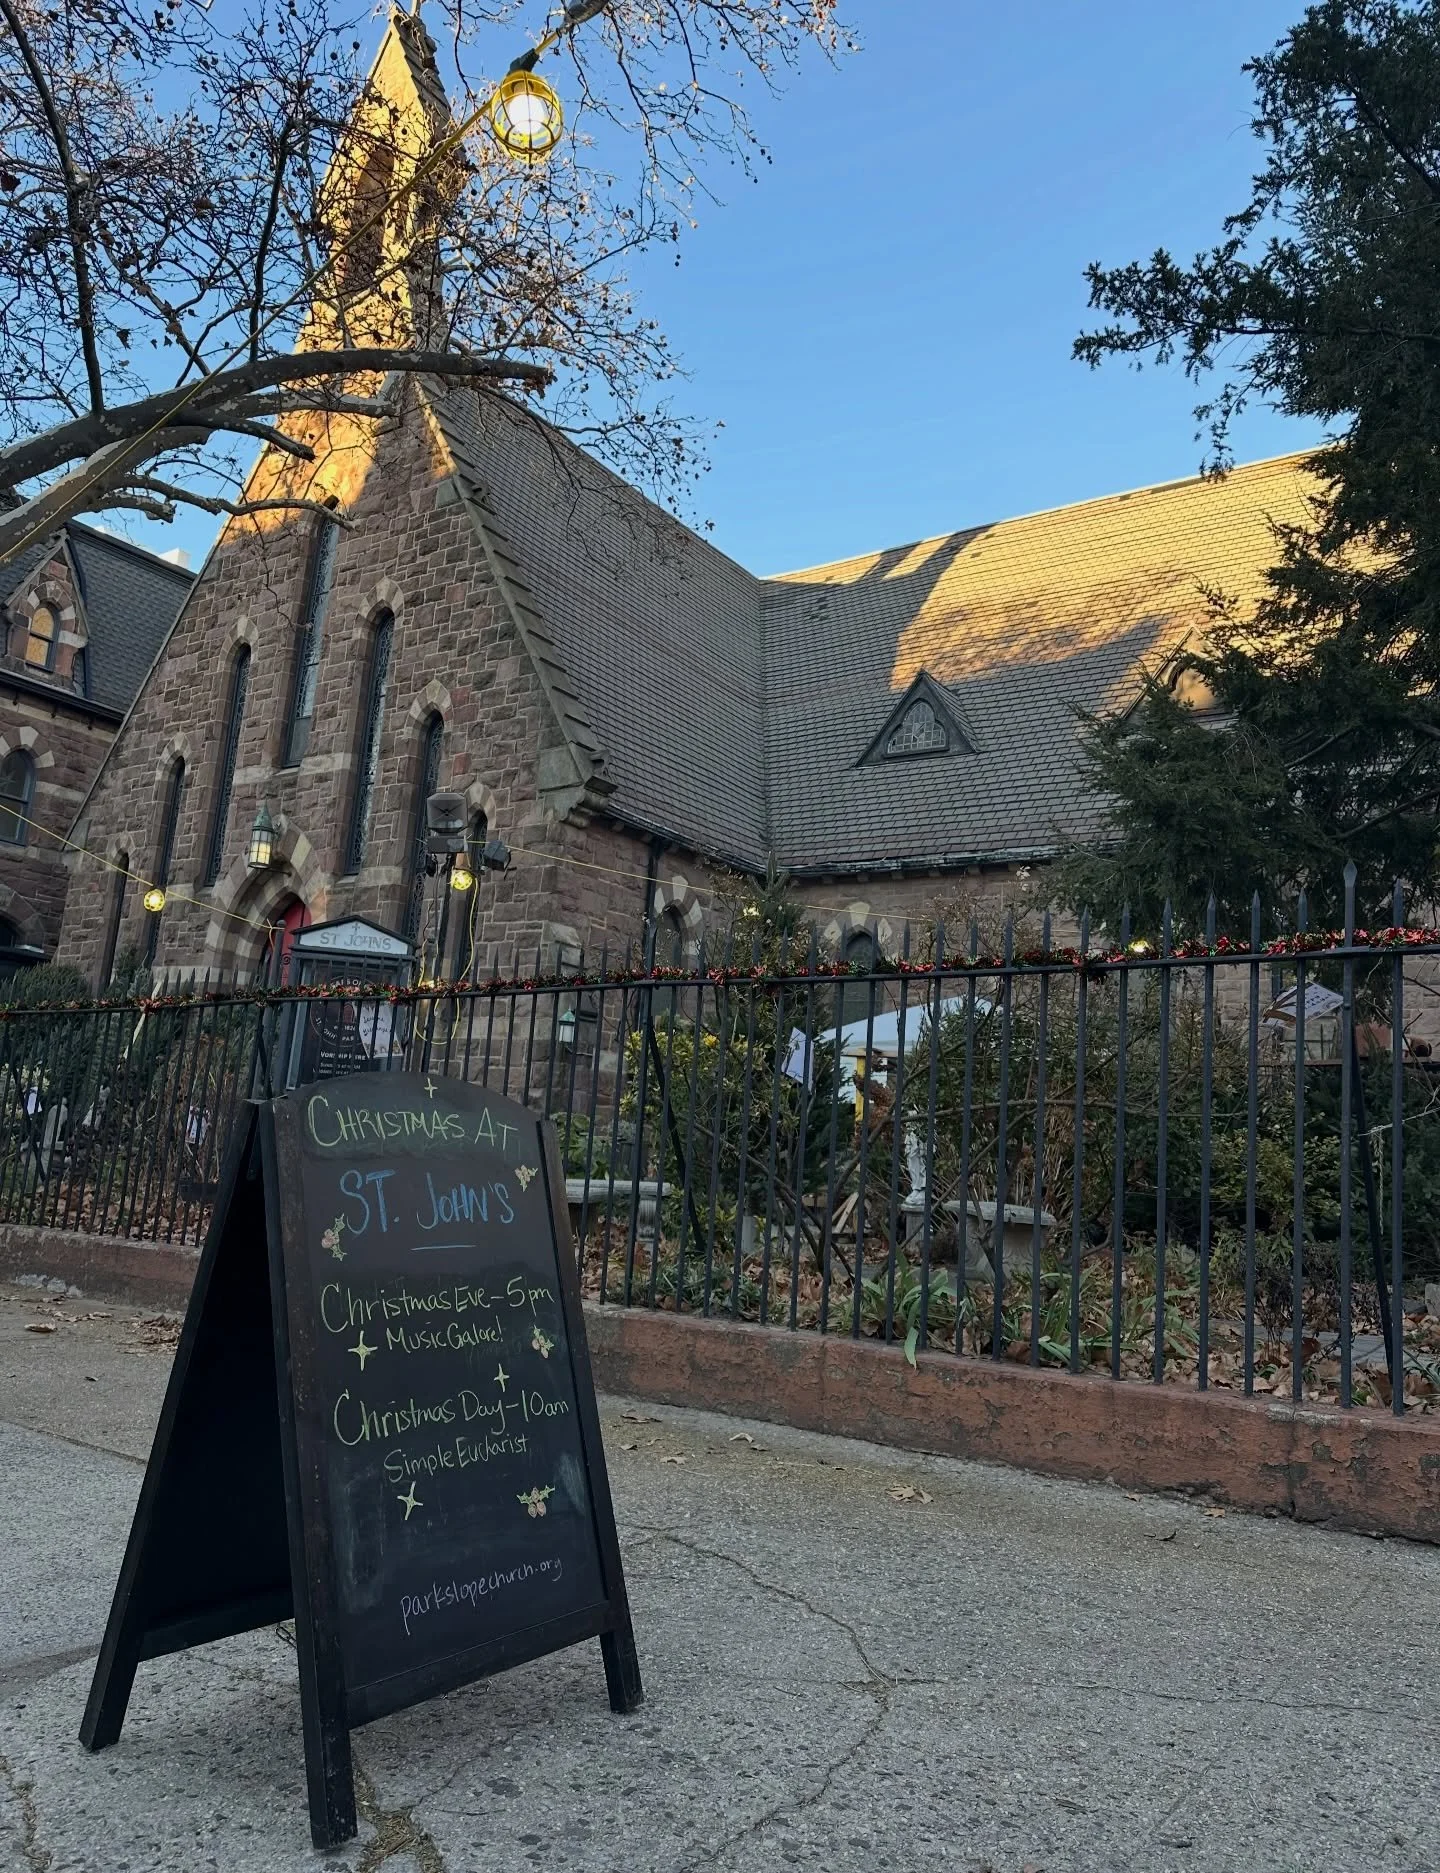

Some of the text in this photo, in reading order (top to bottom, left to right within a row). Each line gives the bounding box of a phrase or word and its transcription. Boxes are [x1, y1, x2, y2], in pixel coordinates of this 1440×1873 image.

[320, 931, 340, 945] ST
[307, 1095, 519, 1151] CHRISTMAS AT
[339, 1169, 515, 1235] ST. JOHN'S
[320, 1283, 452, 1333] Christmas
[447, 1315, 504, 1350] Galore!
[333, 1388, 456, 1446] Christmas
[383, 1445, 455, 1484] Simple
[400, 1557, 563, 1636] parkslopechurch.org
